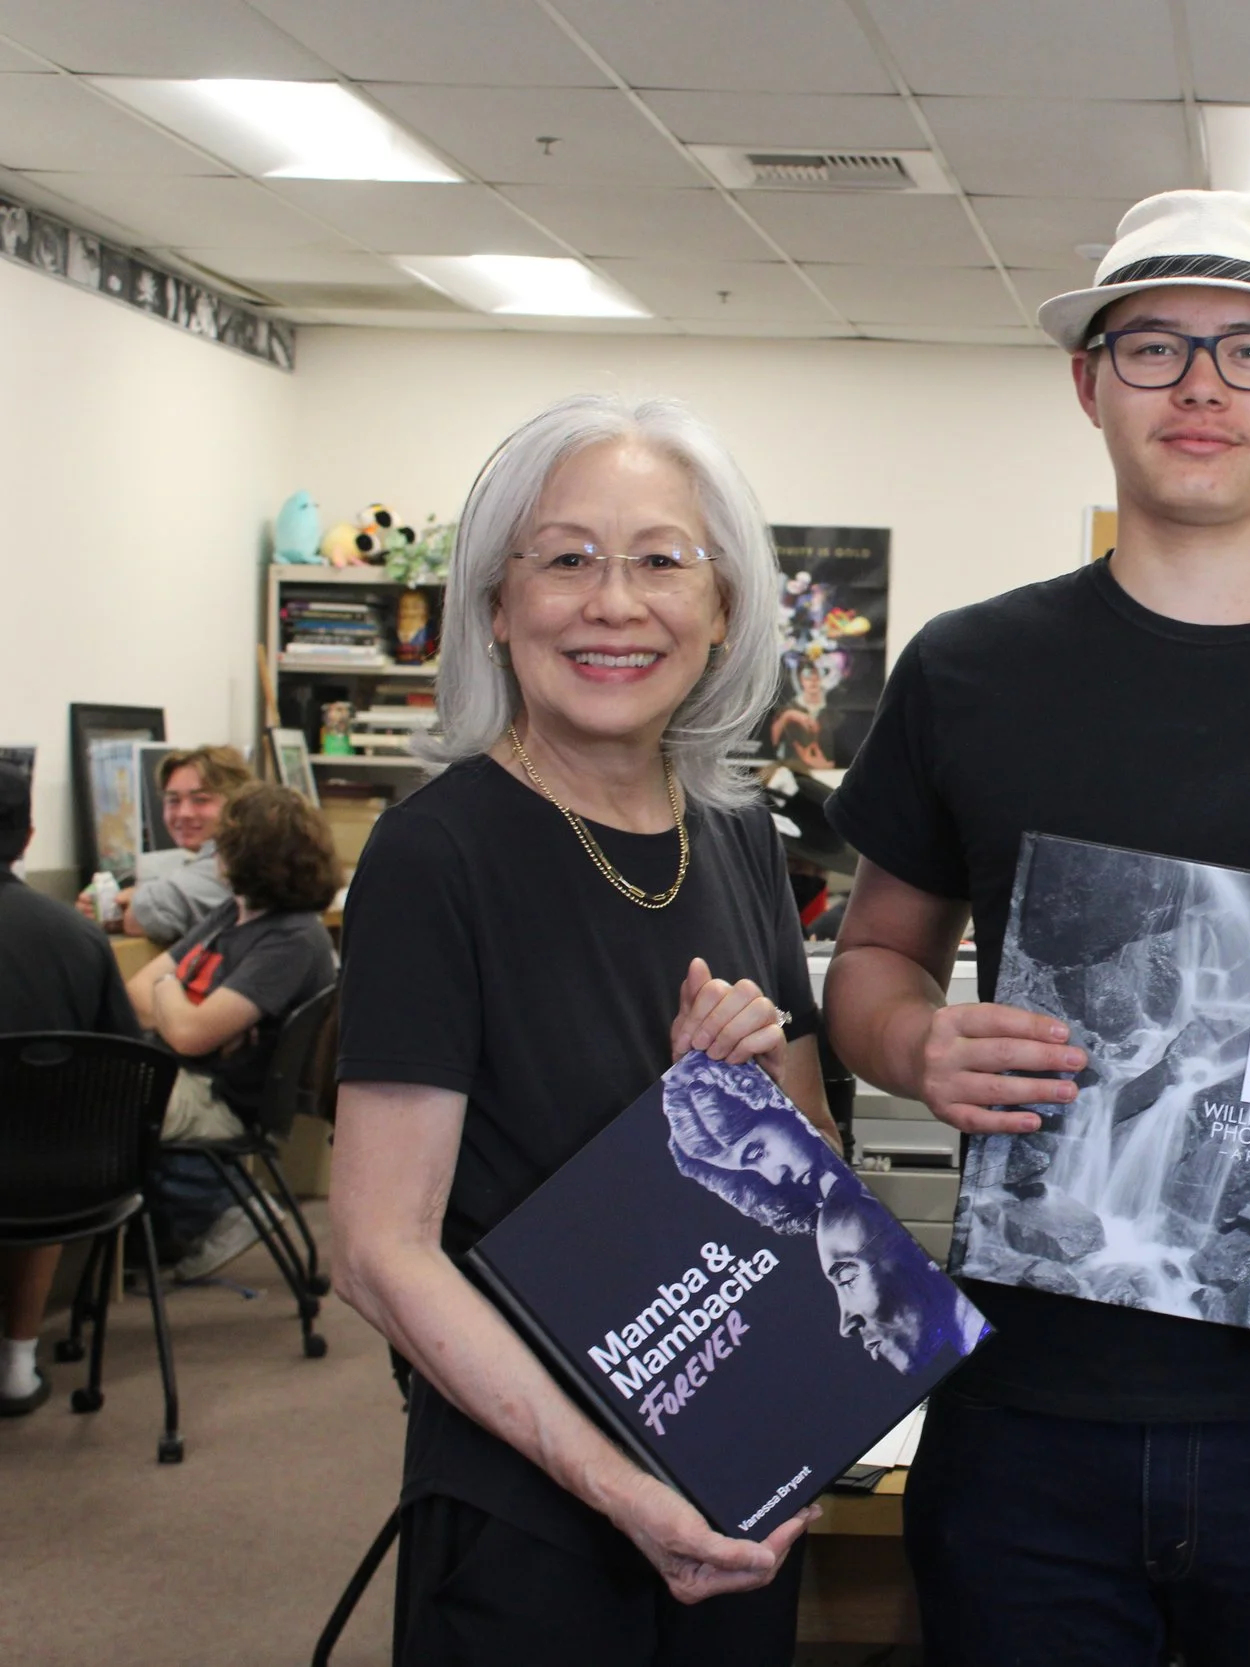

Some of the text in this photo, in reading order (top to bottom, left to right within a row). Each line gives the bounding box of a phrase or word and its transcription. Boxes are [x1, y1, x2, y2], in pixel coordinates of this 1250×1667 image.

[1230, 1148, 1242, 1161] A
[587, 1242, 735, 1374] Mamba &
[609, 1249, 780, 1400] Mambacita
[638, 1309, 750, 1436] FOREVER
[738, 1465, 813, 1532] Vanessa Bryant
